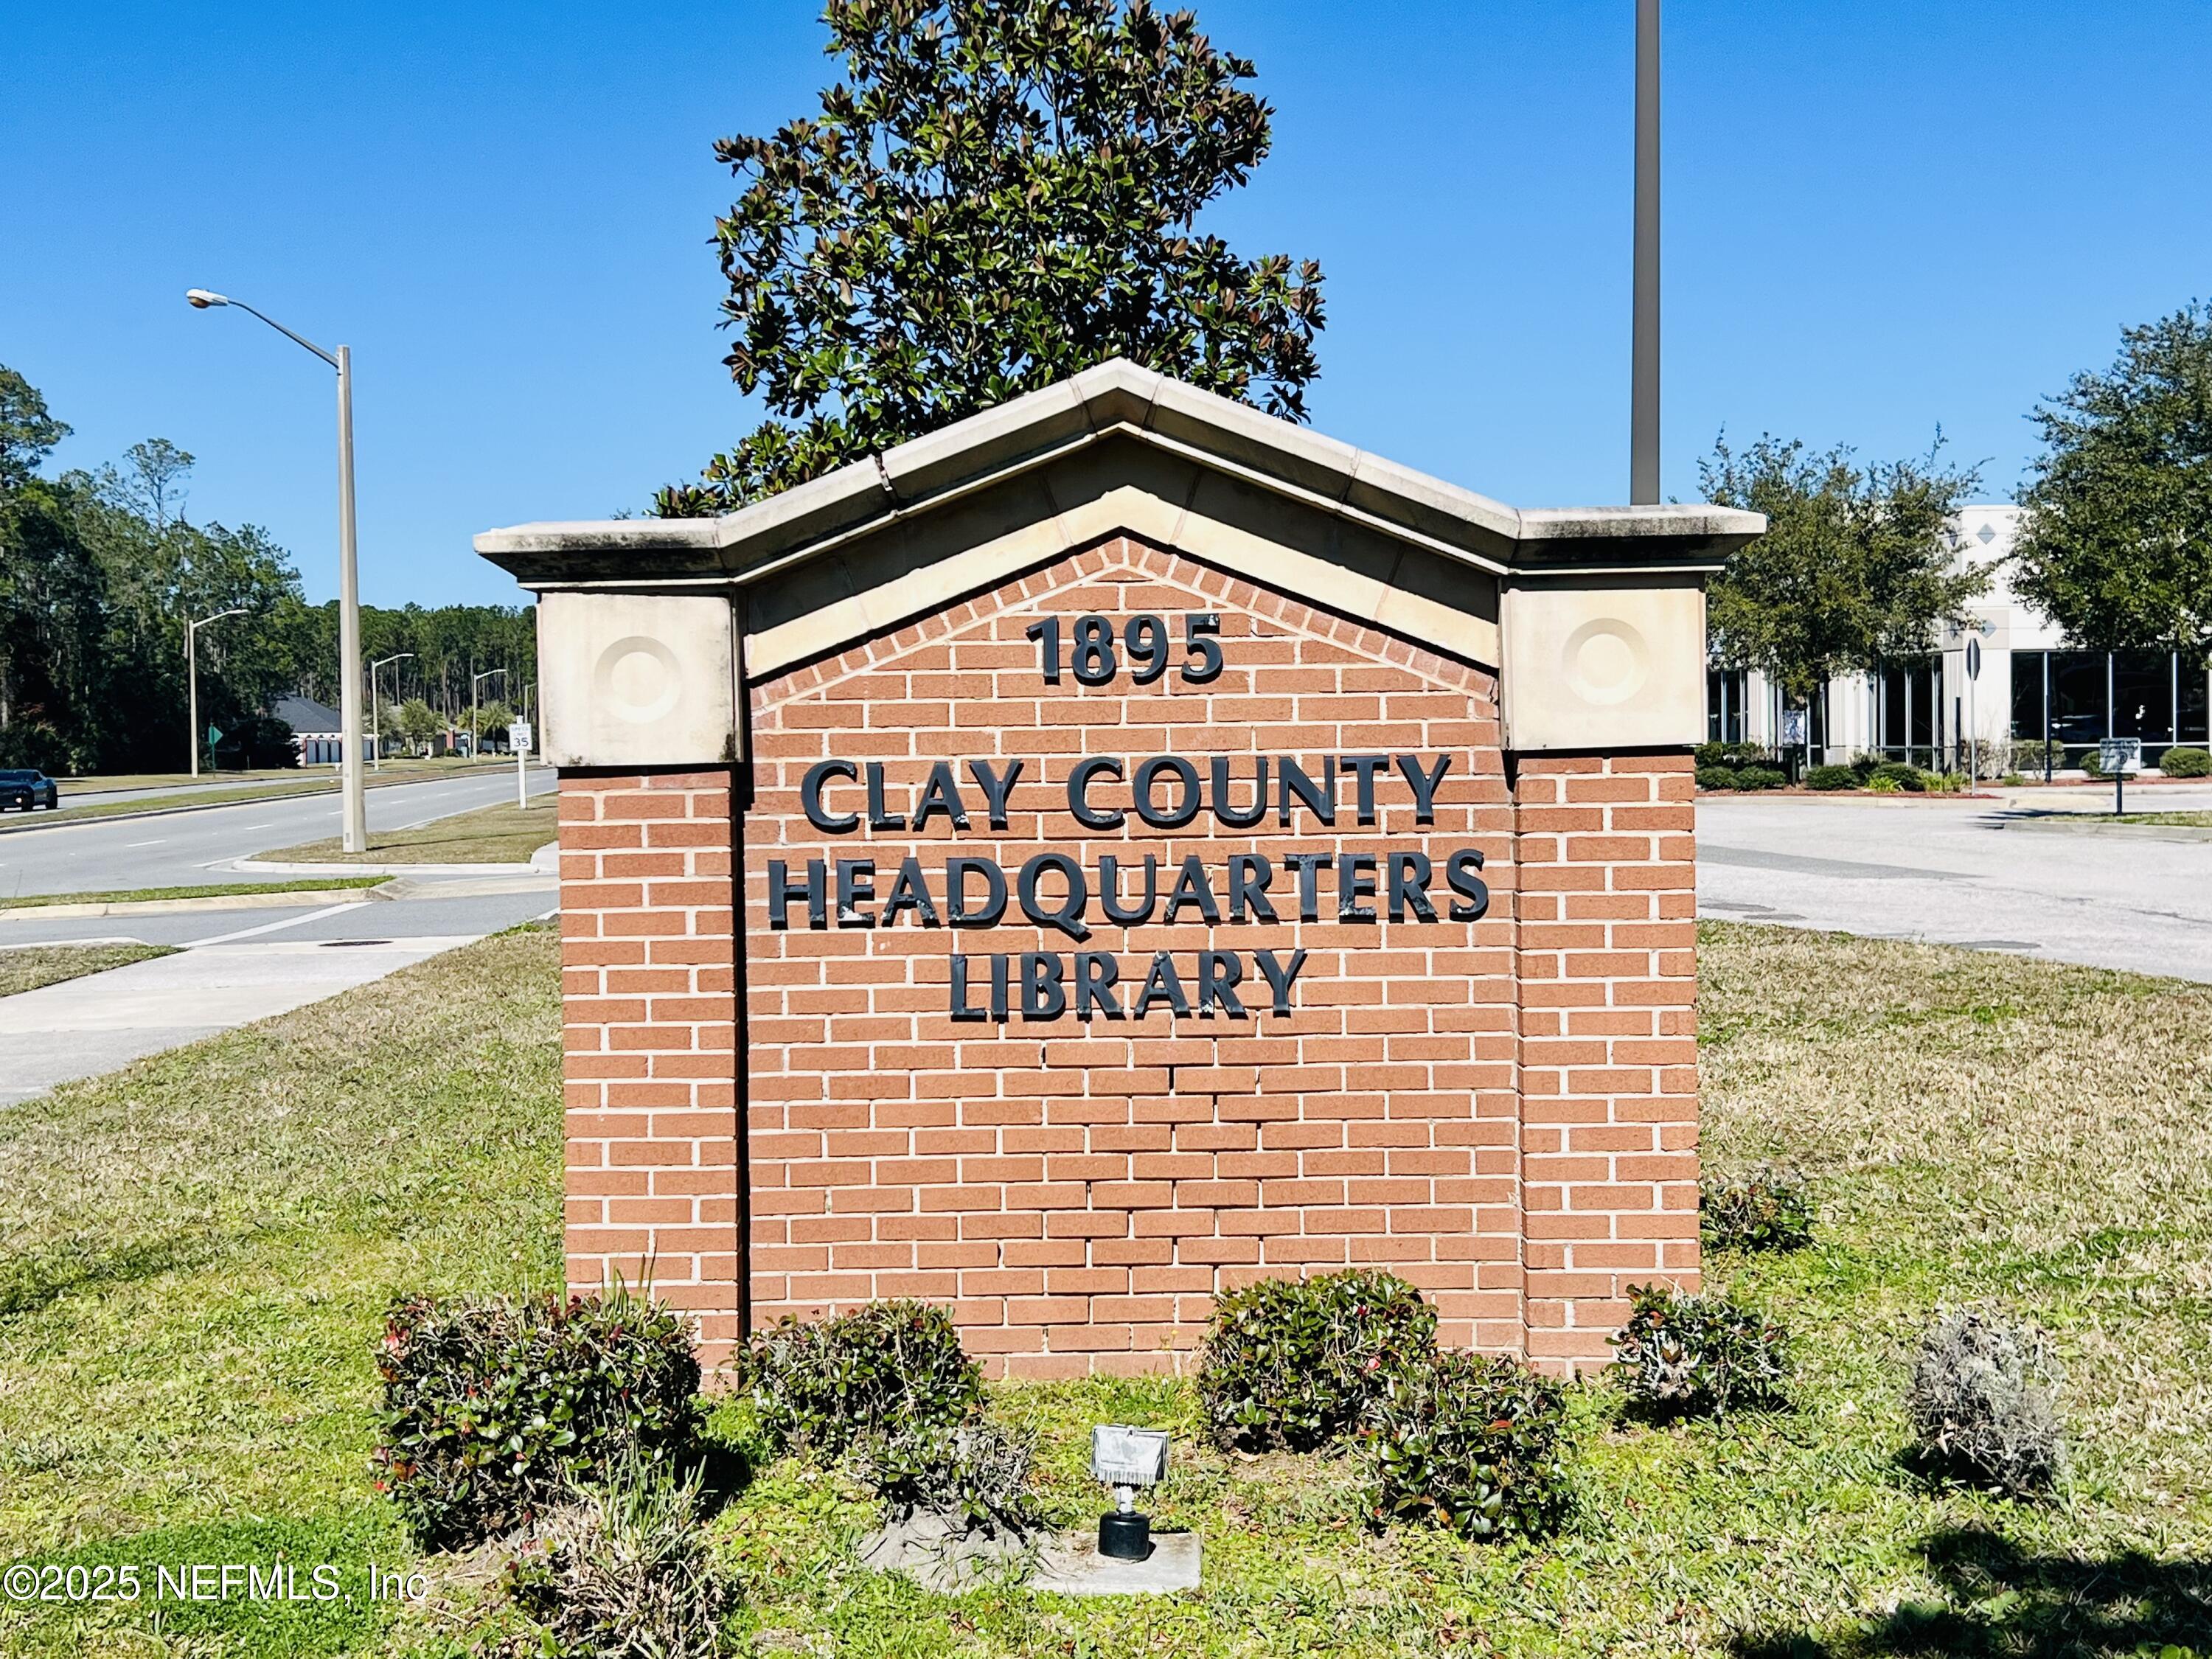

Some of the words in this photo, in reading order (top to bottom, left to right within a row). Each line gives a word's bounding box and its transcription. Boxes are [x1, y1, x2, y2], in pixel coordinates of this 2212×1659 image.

[1026, 614, 1222, 685] 1895
[514, 737, 529, 747] 35
[801, 759, 1023, 833] CLAY
[1067, 755, 1450, 828] COUNTY
[768, 849, 1488, 942] HEADQUARTERS
[950, 949, 1307, 1022] LIBRARY
